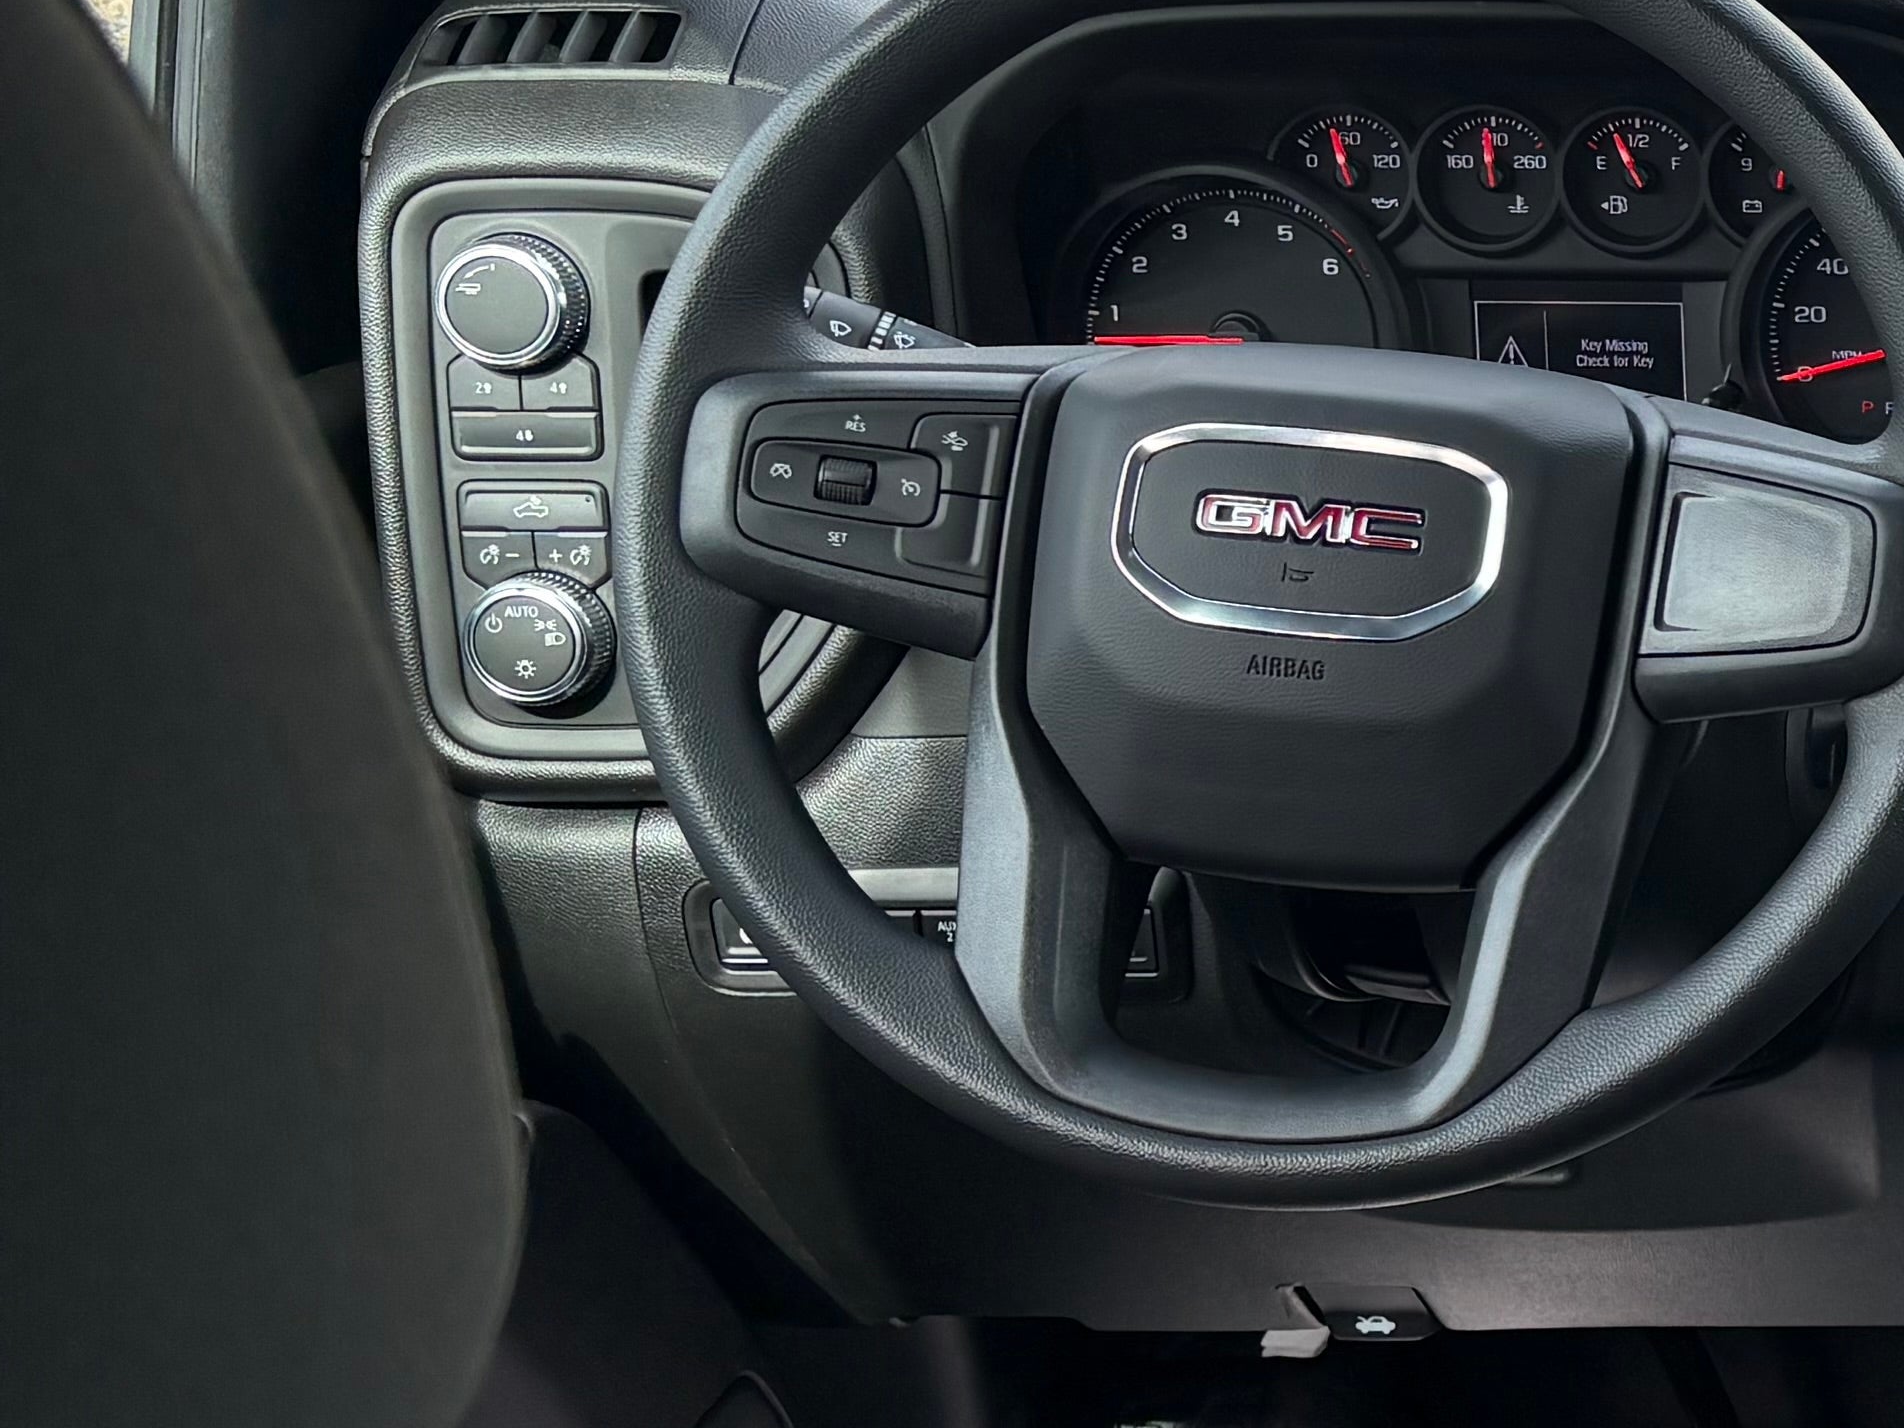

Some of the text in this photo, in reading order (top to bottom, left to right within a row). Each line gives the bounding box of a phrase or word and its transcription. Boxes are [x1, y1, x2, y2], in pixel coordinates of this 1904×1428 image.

[1627, 134, 1650, 148] 1/2
[1305, 154, 1318, 168] 0
[1373, 154, 1400, 169] 120
[1446, 155, 1474, 169] 160
[1513, 155, 1547, 169] 260
[1596, 156, 1608, 170] E
[1671, 157, 1681, 171] F
[1741, 158, 1753, 172] 9
[1225, 210, 1240, 227] 4
[1171, 224, 1188, 241] 3
[1277, 225, 1294, 242] 5
[1132, 256, 1148, 273] 2
[1322, 258, 1339, 275] 6
[1817, 258, 1849, 275] 40
[1110, 305, 1119, 322] 1
[1794, 306, 1827, 323] 20
[1581, 338, 1649, 355] Key Missing
[1576, 354, 1654, 369] Check for Key
[1861, 401, 1874, 414] P
[845, 420, 866, 433] RES
[1195, 493, 1423, 550] GMC
[827, 531, 848, 543] SET
[504, 605, 539, 618] AUTO
[1246, 654, 1326, 681] AIRBAG
